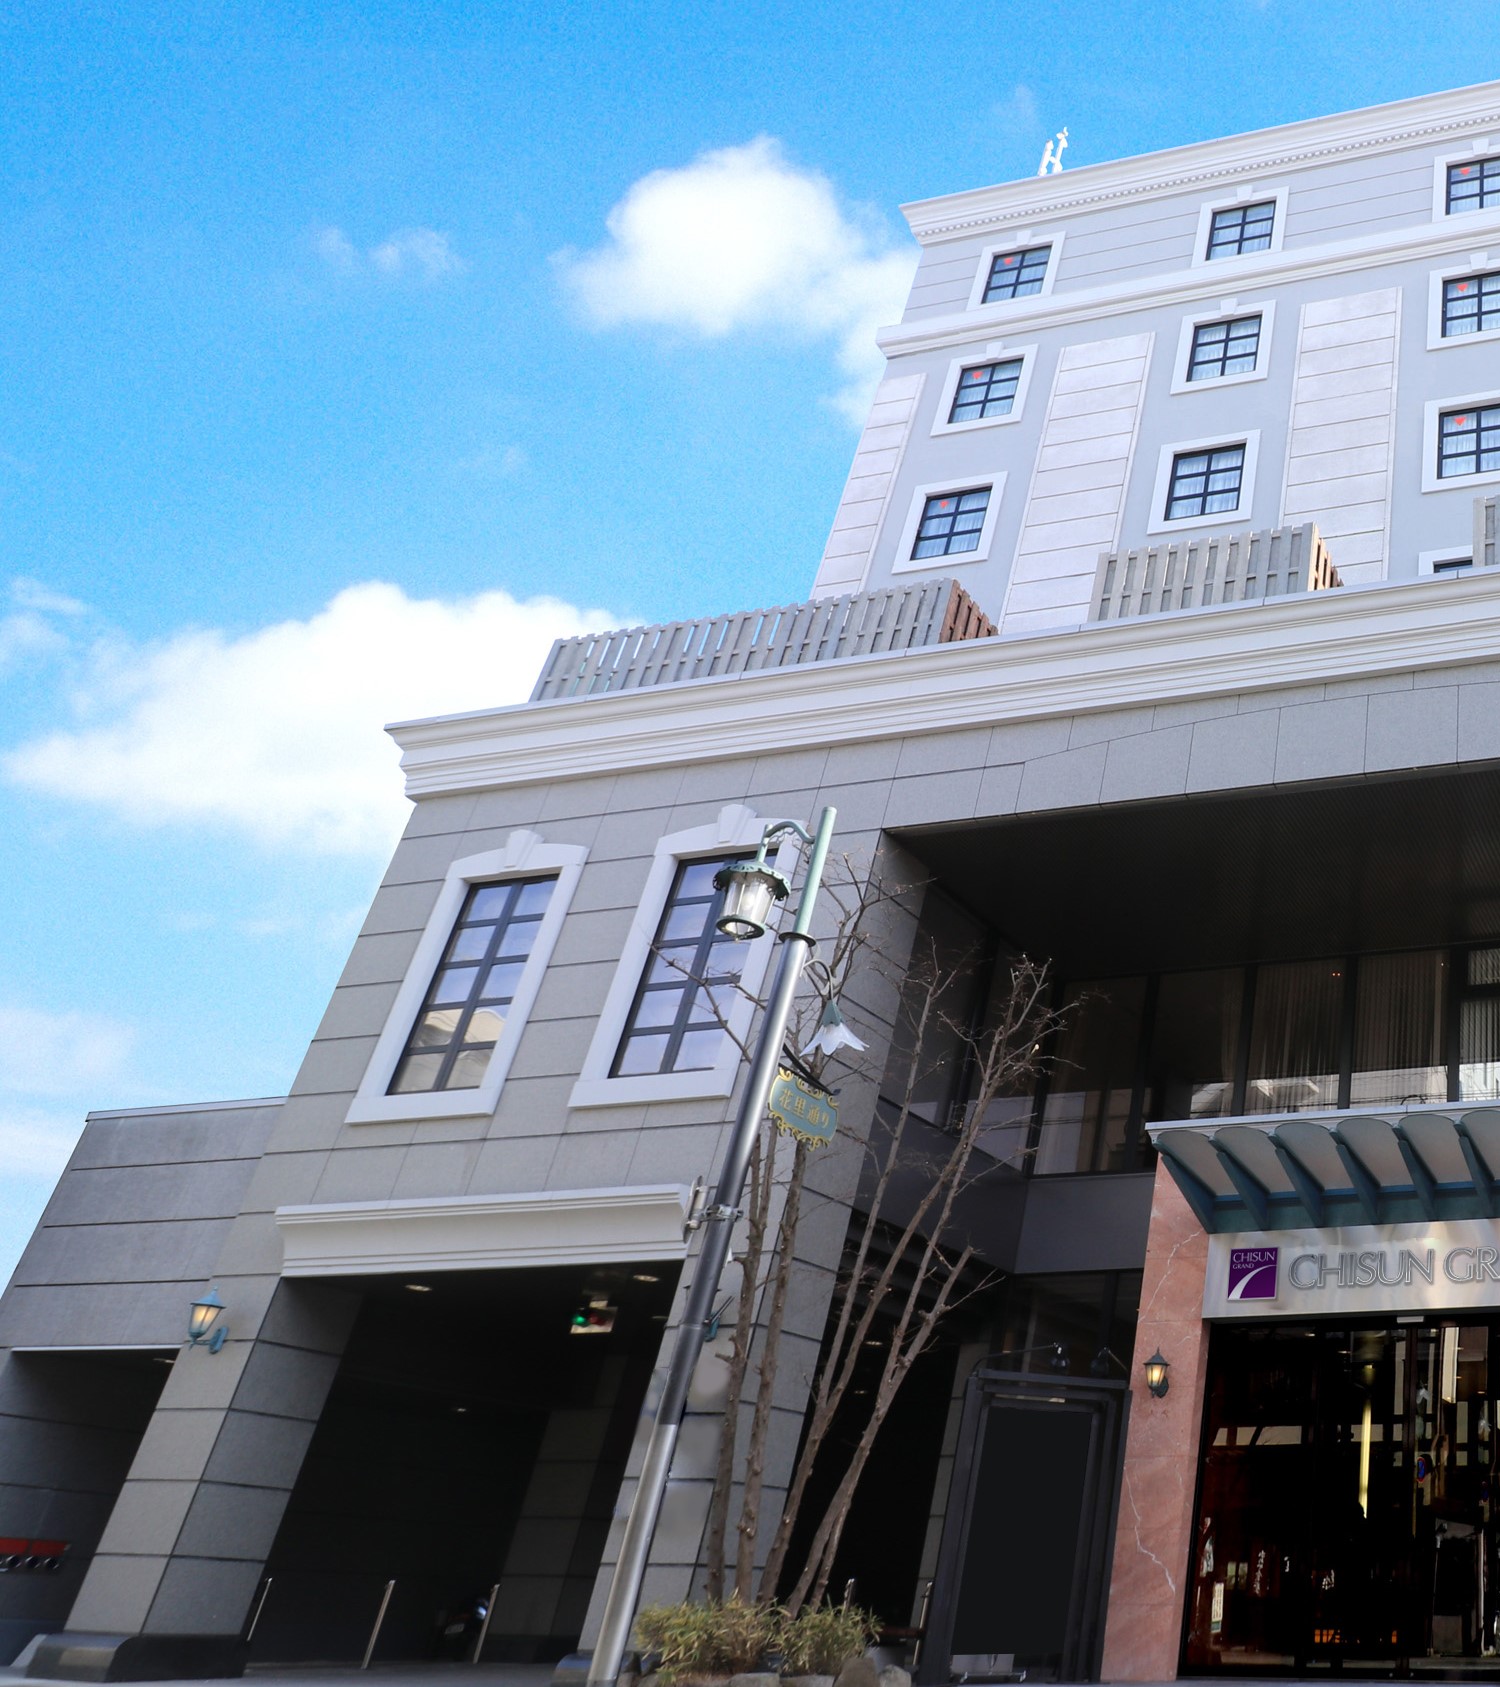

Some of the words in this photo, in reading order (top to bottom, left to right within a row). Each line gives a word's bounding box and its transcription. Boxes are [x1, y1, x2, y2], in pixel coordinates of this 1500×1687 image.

[779, 1088, 829, 1128] 花里通り
[1233, 1251, 1275, 1263] CHISUN
[1289, 1249, 1434, 1288] CHISUN
